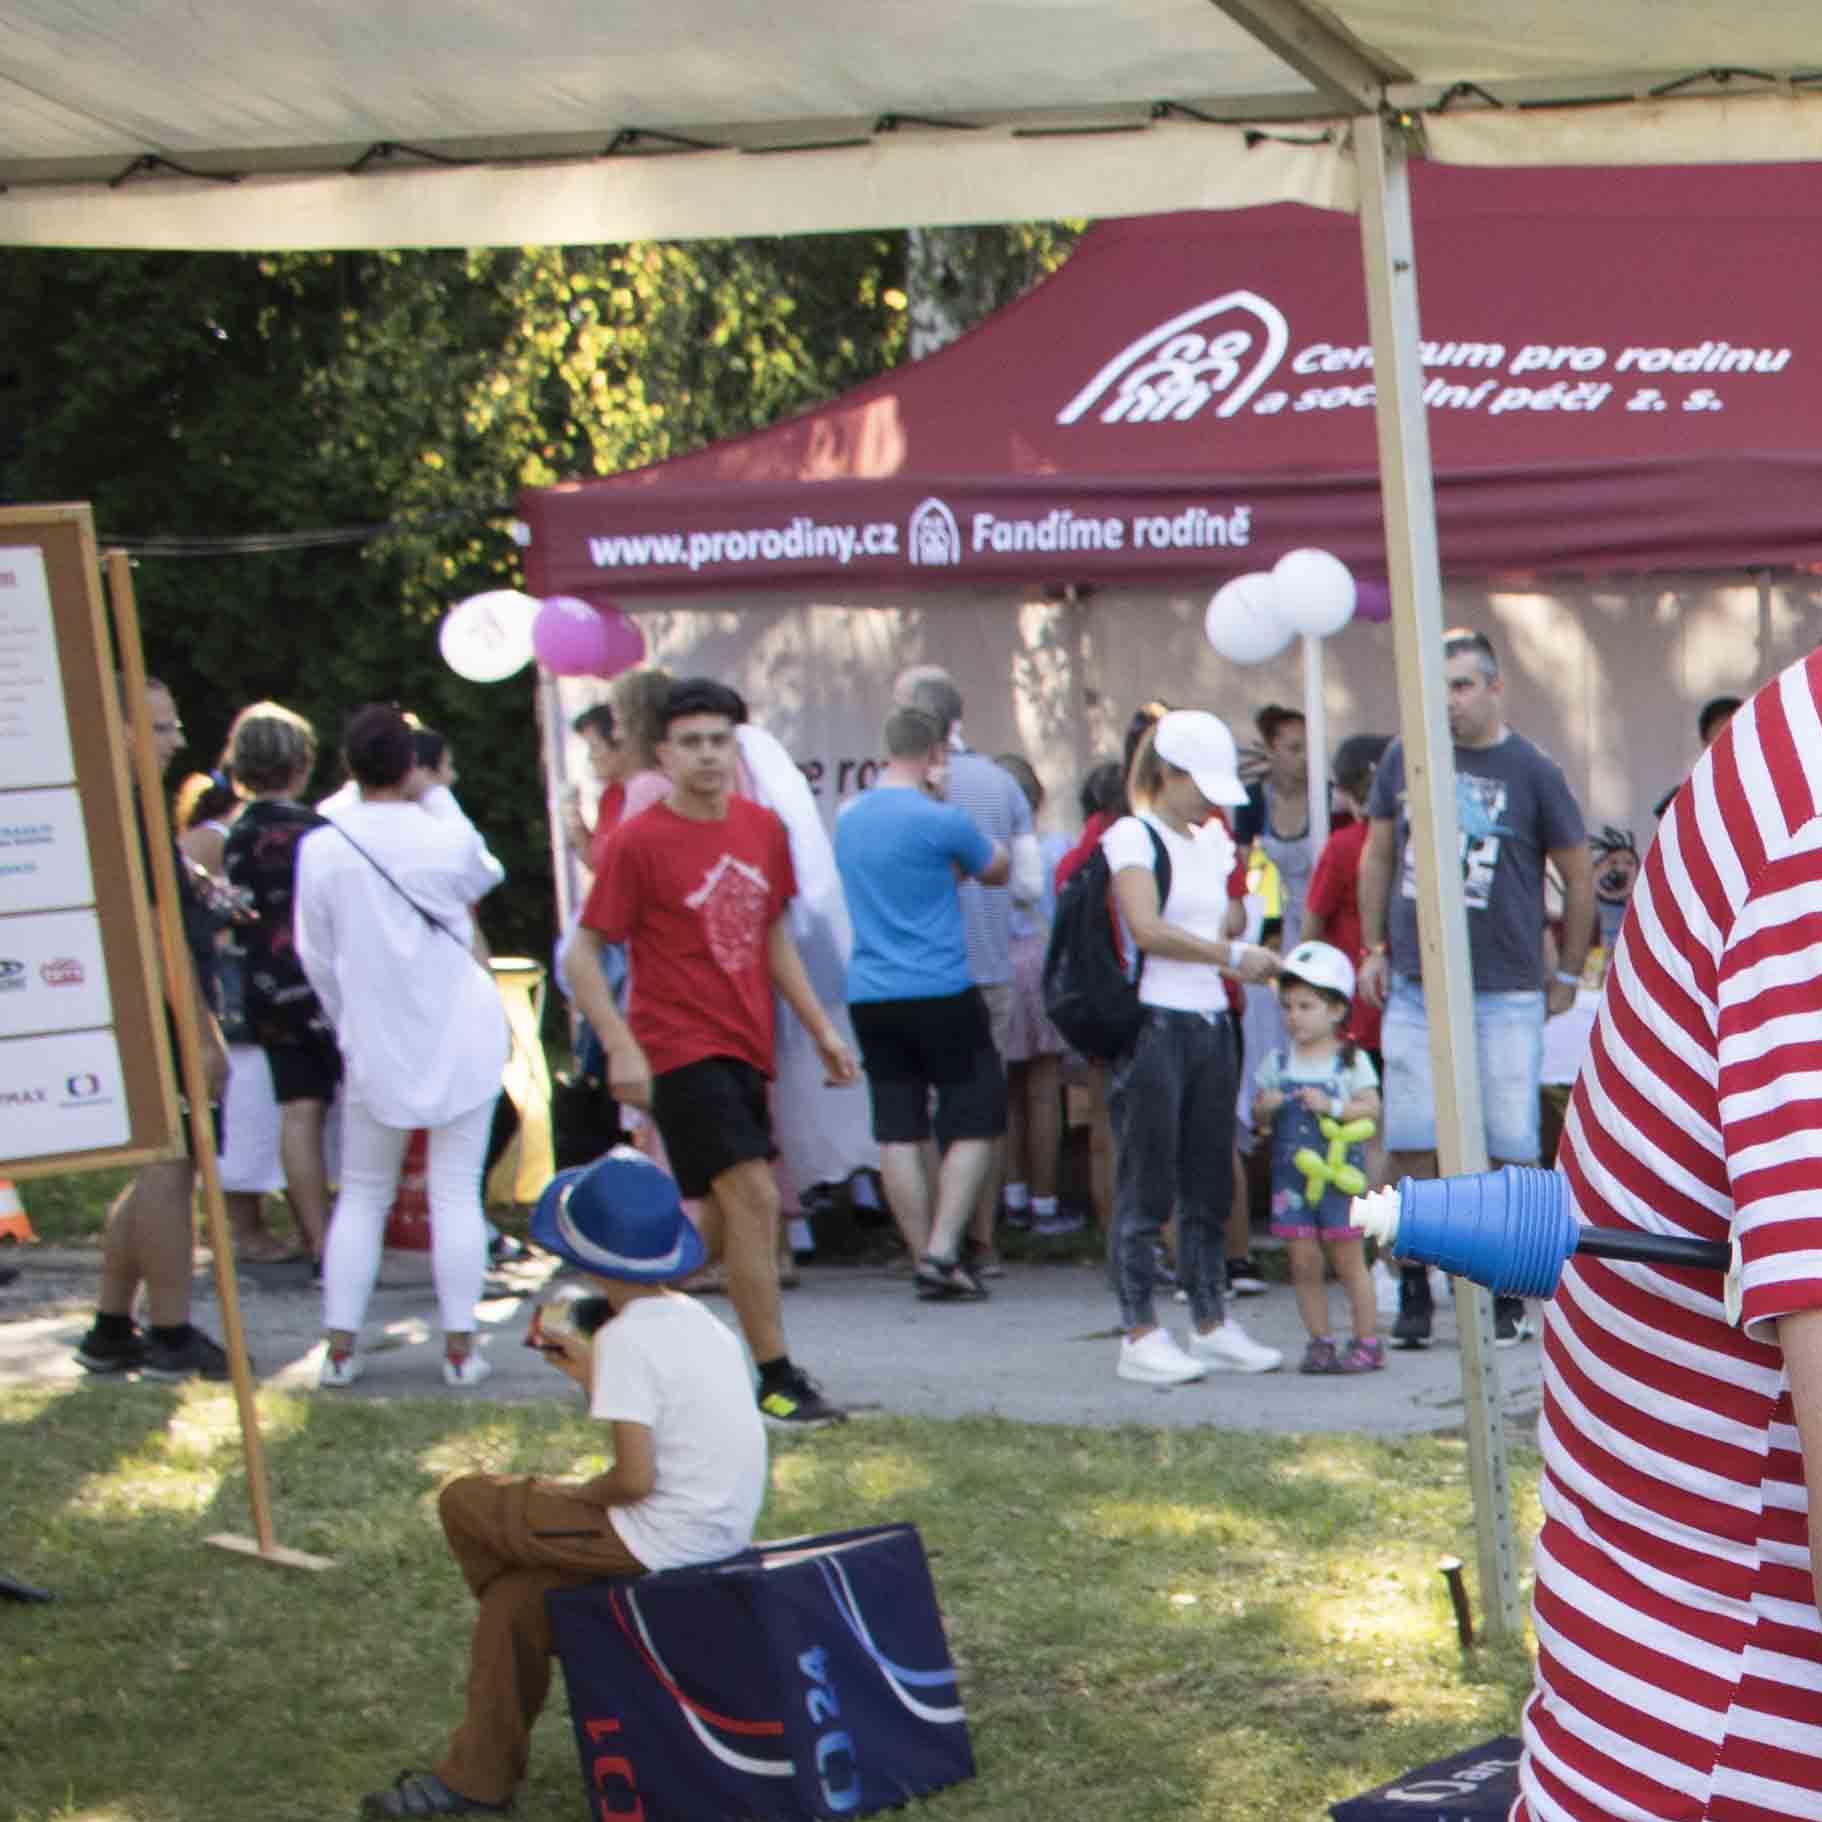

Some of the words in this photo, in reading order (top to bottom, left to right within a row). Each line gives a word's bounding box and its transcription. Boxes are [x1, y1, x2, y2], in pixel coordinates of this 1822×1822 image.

[1291, 341, 1505, 374] Cenum
[1509, 344, 1607, 375] pro
[1614, 341, 1792, 373] rodinu
[1253, 391, 1289, 415] a
[1293, 377, 1498, 412] soclní
[1626, 388, 1667, 412] z.
[1682, 388, 1724, 412] s.
[589, 516, 899, 571] www.prorodiny.cz
[972, 509, 1125, 552] Fandíme
[1133, 505, 1252, 548] rodině
[797, 1645, 841, 1724] 24
